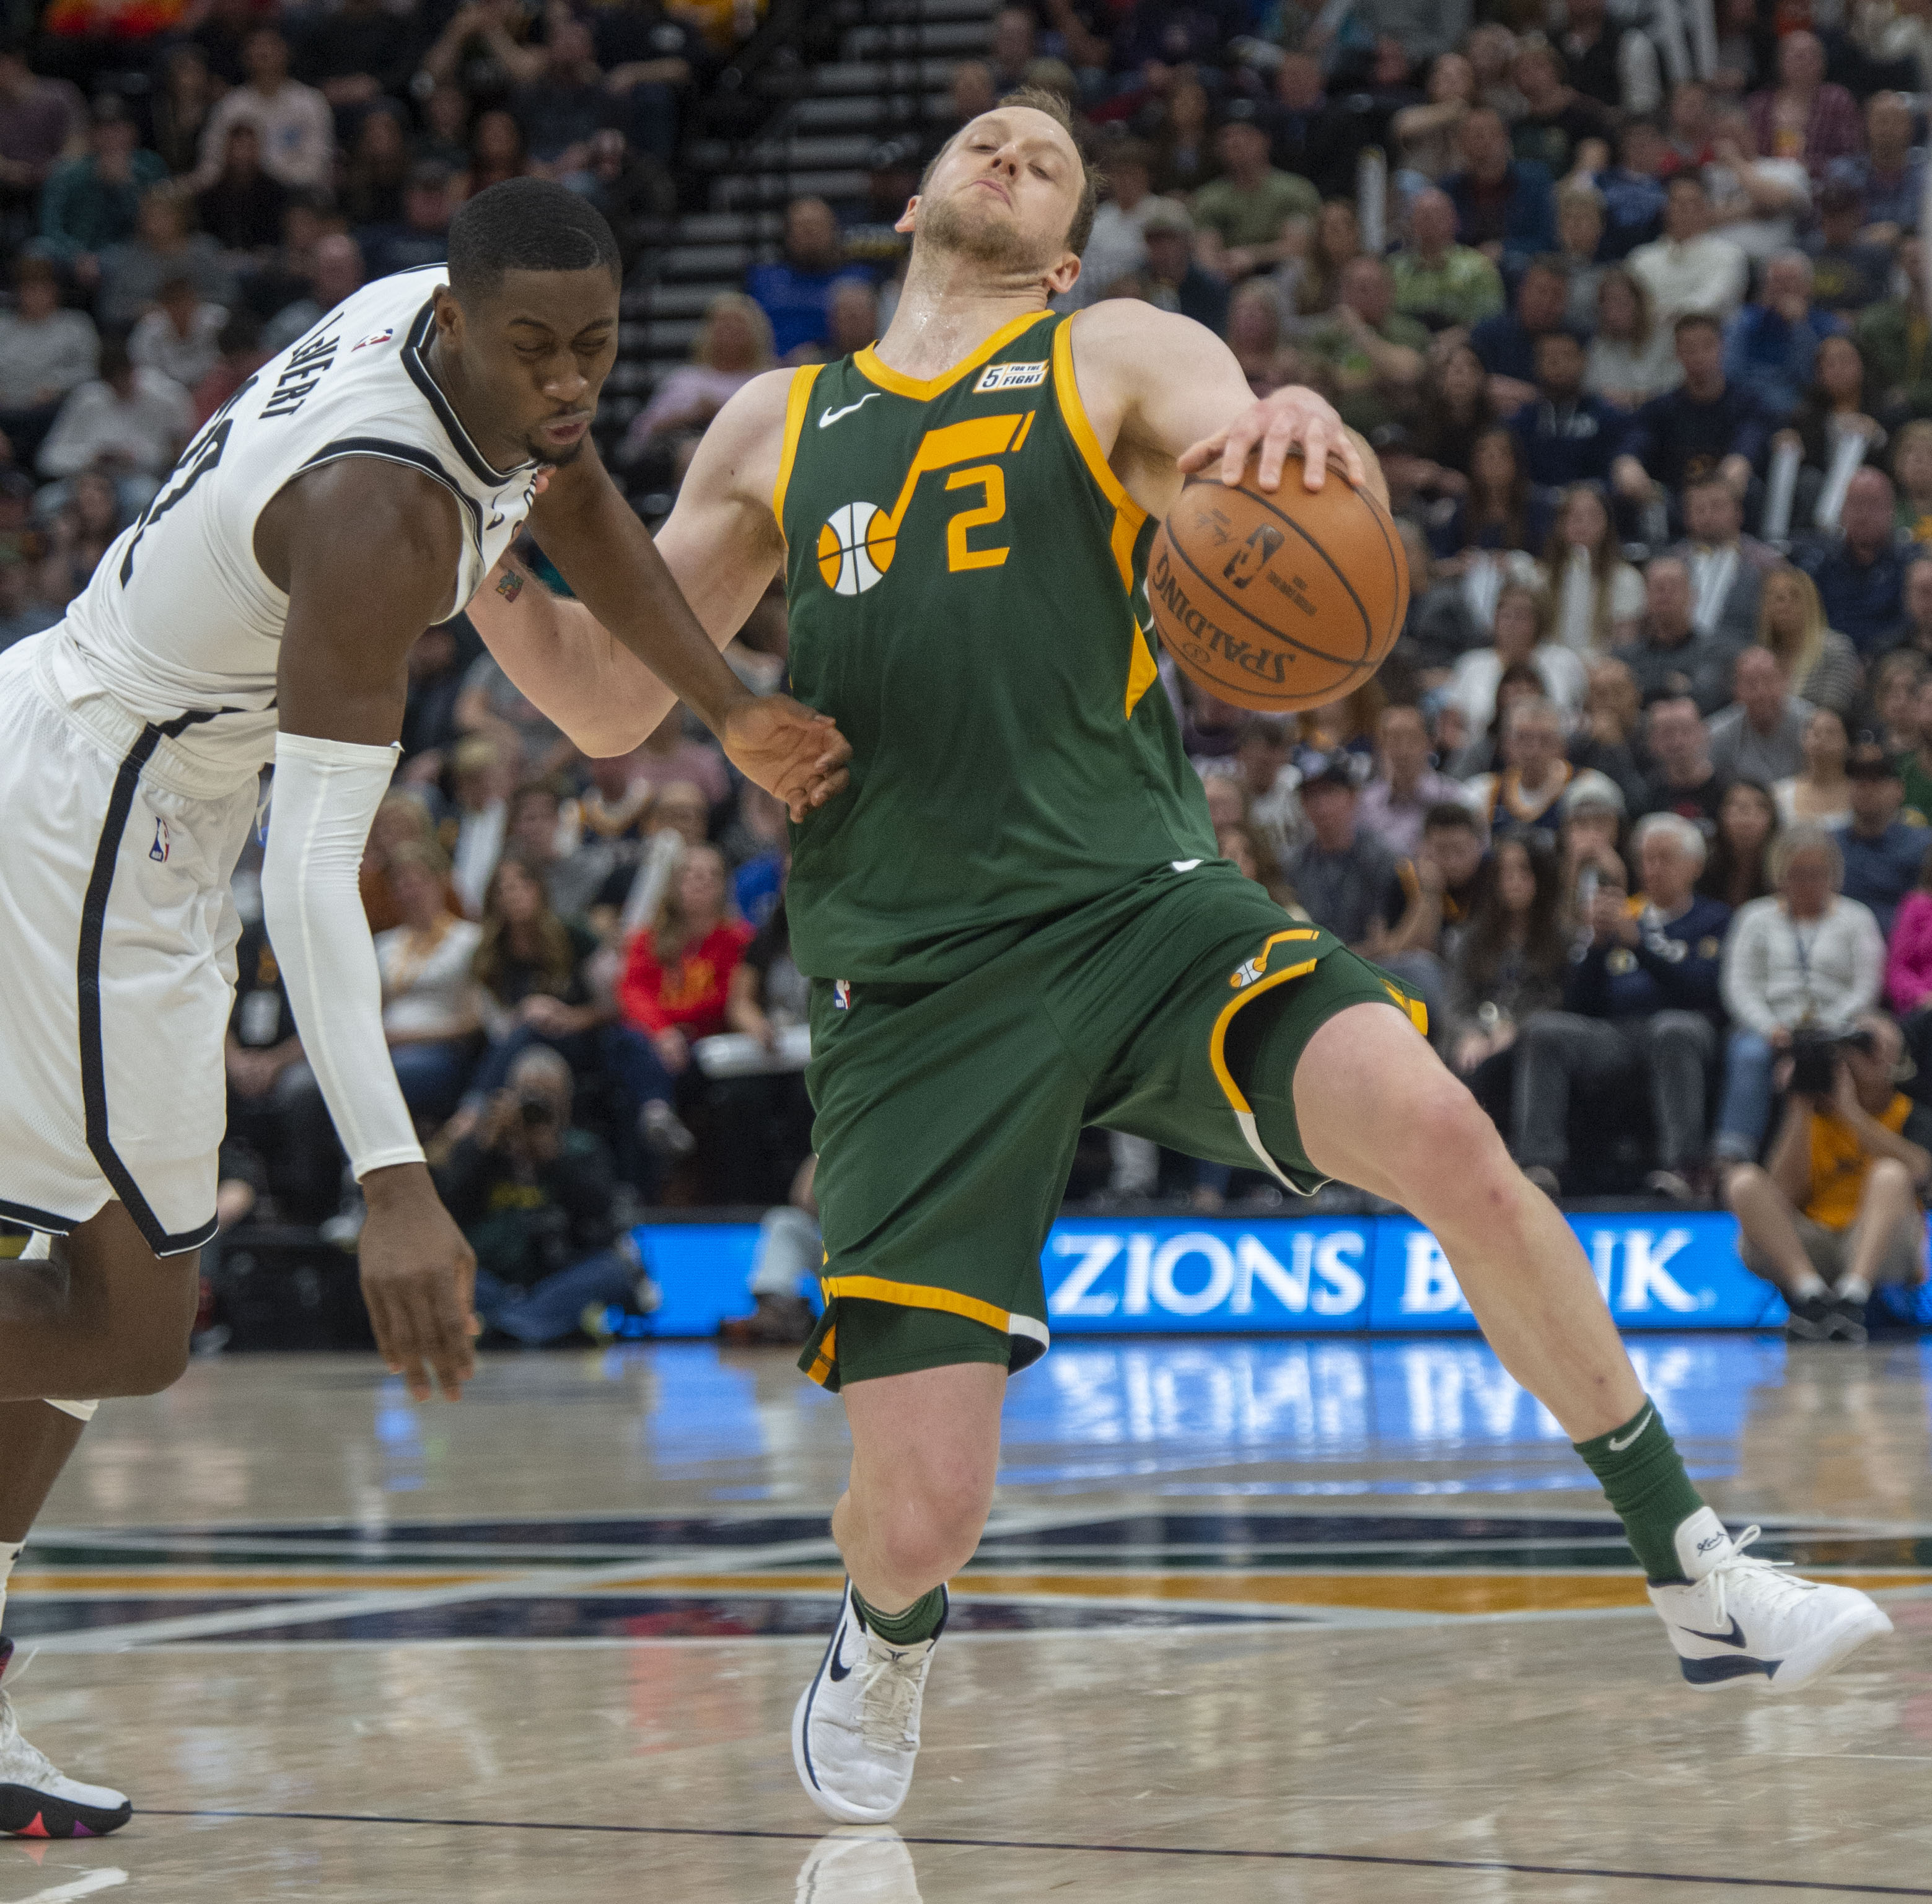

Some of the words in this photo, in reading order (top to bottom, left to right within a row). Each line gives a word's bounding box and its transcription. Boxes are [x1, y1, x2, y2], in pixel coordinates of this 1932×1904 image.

[982, 367, 1003, 388] 5
[1003, 373, 1043, 385] FIGHT
[945, 464, 1011, 573] 2
[1151, 548, 1296, 682] SPALDING
[1048, 1231, 1366, 1316] ZIONS
[1400, 1228, 1699, 1314] BK
